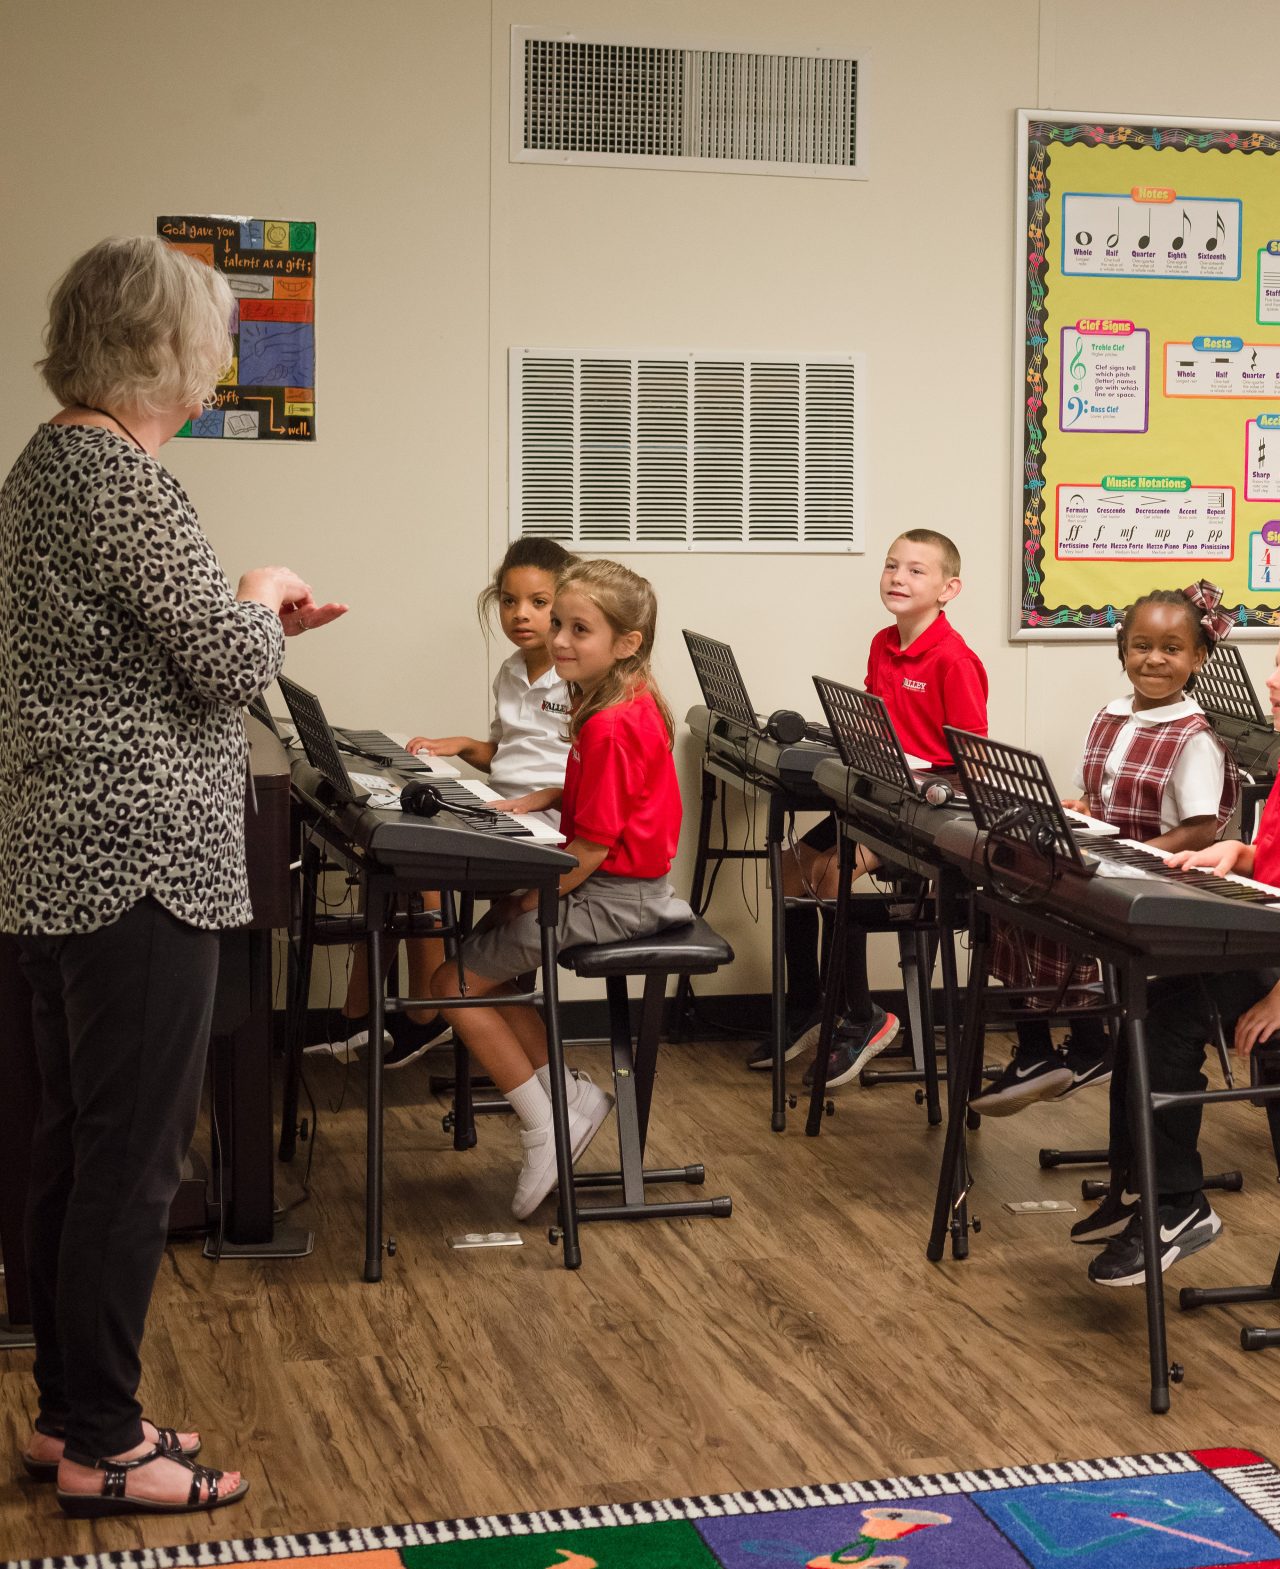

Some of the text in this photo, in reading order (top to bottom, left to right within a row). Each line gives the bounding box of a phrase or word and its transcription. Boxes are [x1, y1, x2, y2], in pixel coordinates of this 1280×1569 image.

[1138, 188, 1169, 199] Notes
[162, 221, 235, 240] God gave you
[1073, 248, 1093, 256] Whole
[1105, 249, 1119, 257] Half
[1131, 250, 1156, 258] Quarter
[1167, 251, 1187, 260] Eighth
[1197, 252, 1226, 260] Sixteenth
[223, 253, 312, 273] talents as a gift;
[1079, 320, 1131, 333] Clef Signs
[1203, 338, 1232, 349] Rests
[1177, 370, 1196, 378] Whole
[1215, 371, 1228, 379] Half
[1241, 371, 1266, 379] Quarter
[216, 390, 240, 409] gifts
[1090, 405, 1119, 413] Bass Clef
[288, 421, 311, 436] well.
[1252, 471, 1271, 480] Sharp
[1106, 477, 1187, 489] Music Notations
[1206, 508, 1226, 516] Repeat
[542, 699, 567, 713] VALLE
